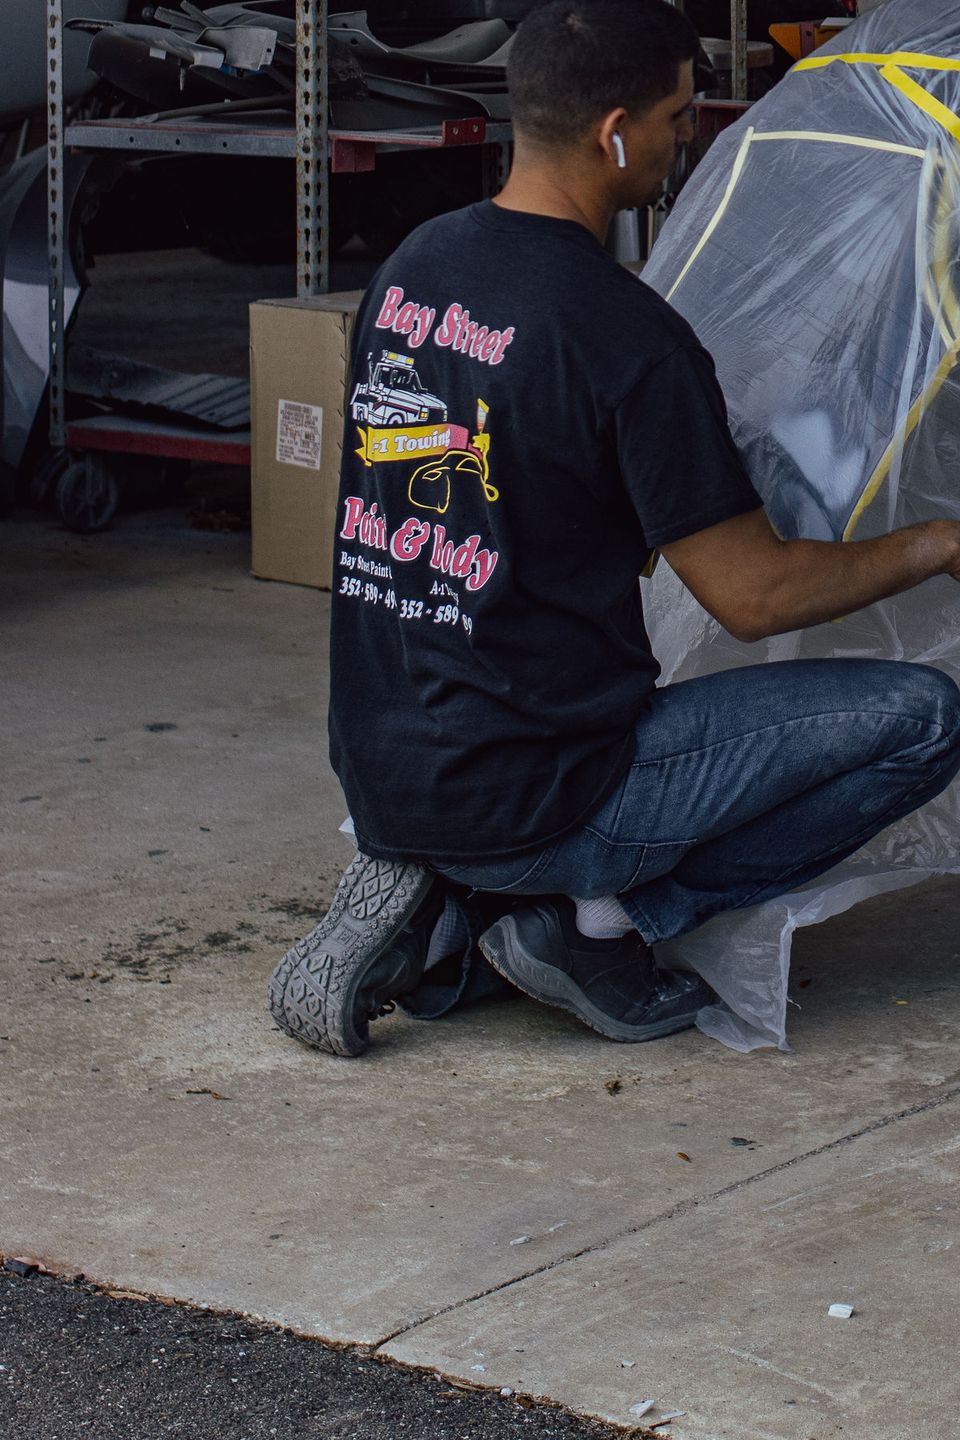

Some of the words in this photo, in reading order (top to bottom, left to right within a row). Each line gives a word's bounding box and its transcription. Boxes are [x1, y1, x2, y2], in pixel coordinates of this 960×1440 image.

[375, 286, 436, 348] Bay
[434, 303, 515, 365] Street
[340, 551, 356, 570] Bay
[370, 561, 389, 578] Paint
[390, 517, 431, 561] &
[430, 524, 499, 591] Body
